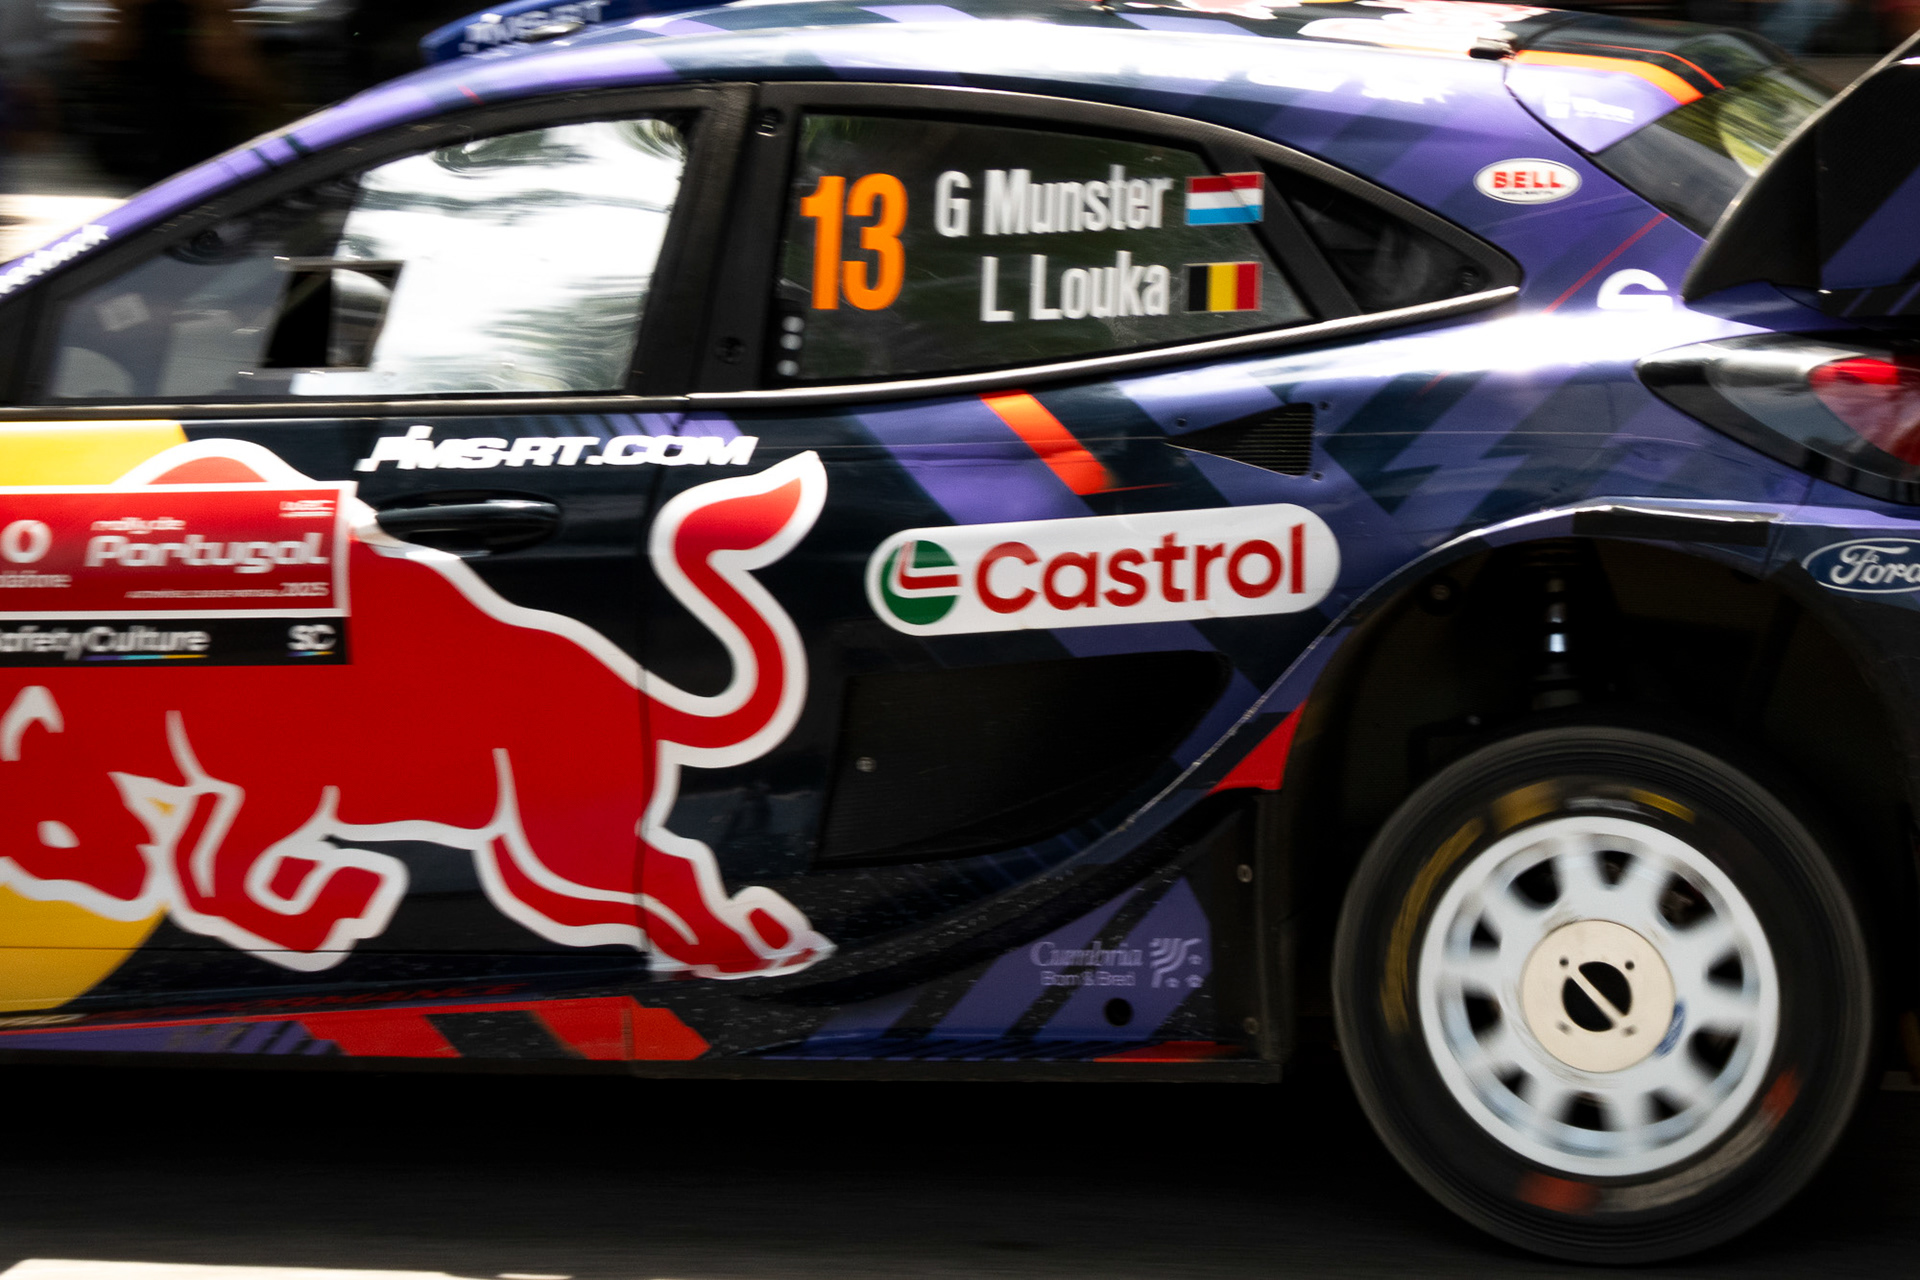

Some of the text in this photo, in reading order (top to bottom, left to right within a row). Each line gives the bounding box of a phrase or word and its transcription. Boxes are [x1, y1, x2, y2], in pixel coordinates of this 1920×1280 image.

[1494, 171, 1566, 188] BELL
[934, 164, 1172, 238] G Munster
[800, 173, 908, 311] 13
[980, 250, 1171, 322] L Louka
[85, 532, 330, 573] Portugal
[975, 522, 1306, 615] Castrol
[0, 624, 212, 661] afetyCulture
[288, 624, 337, 651] SC
[1030, 940, 1144, 967] Cumbria
